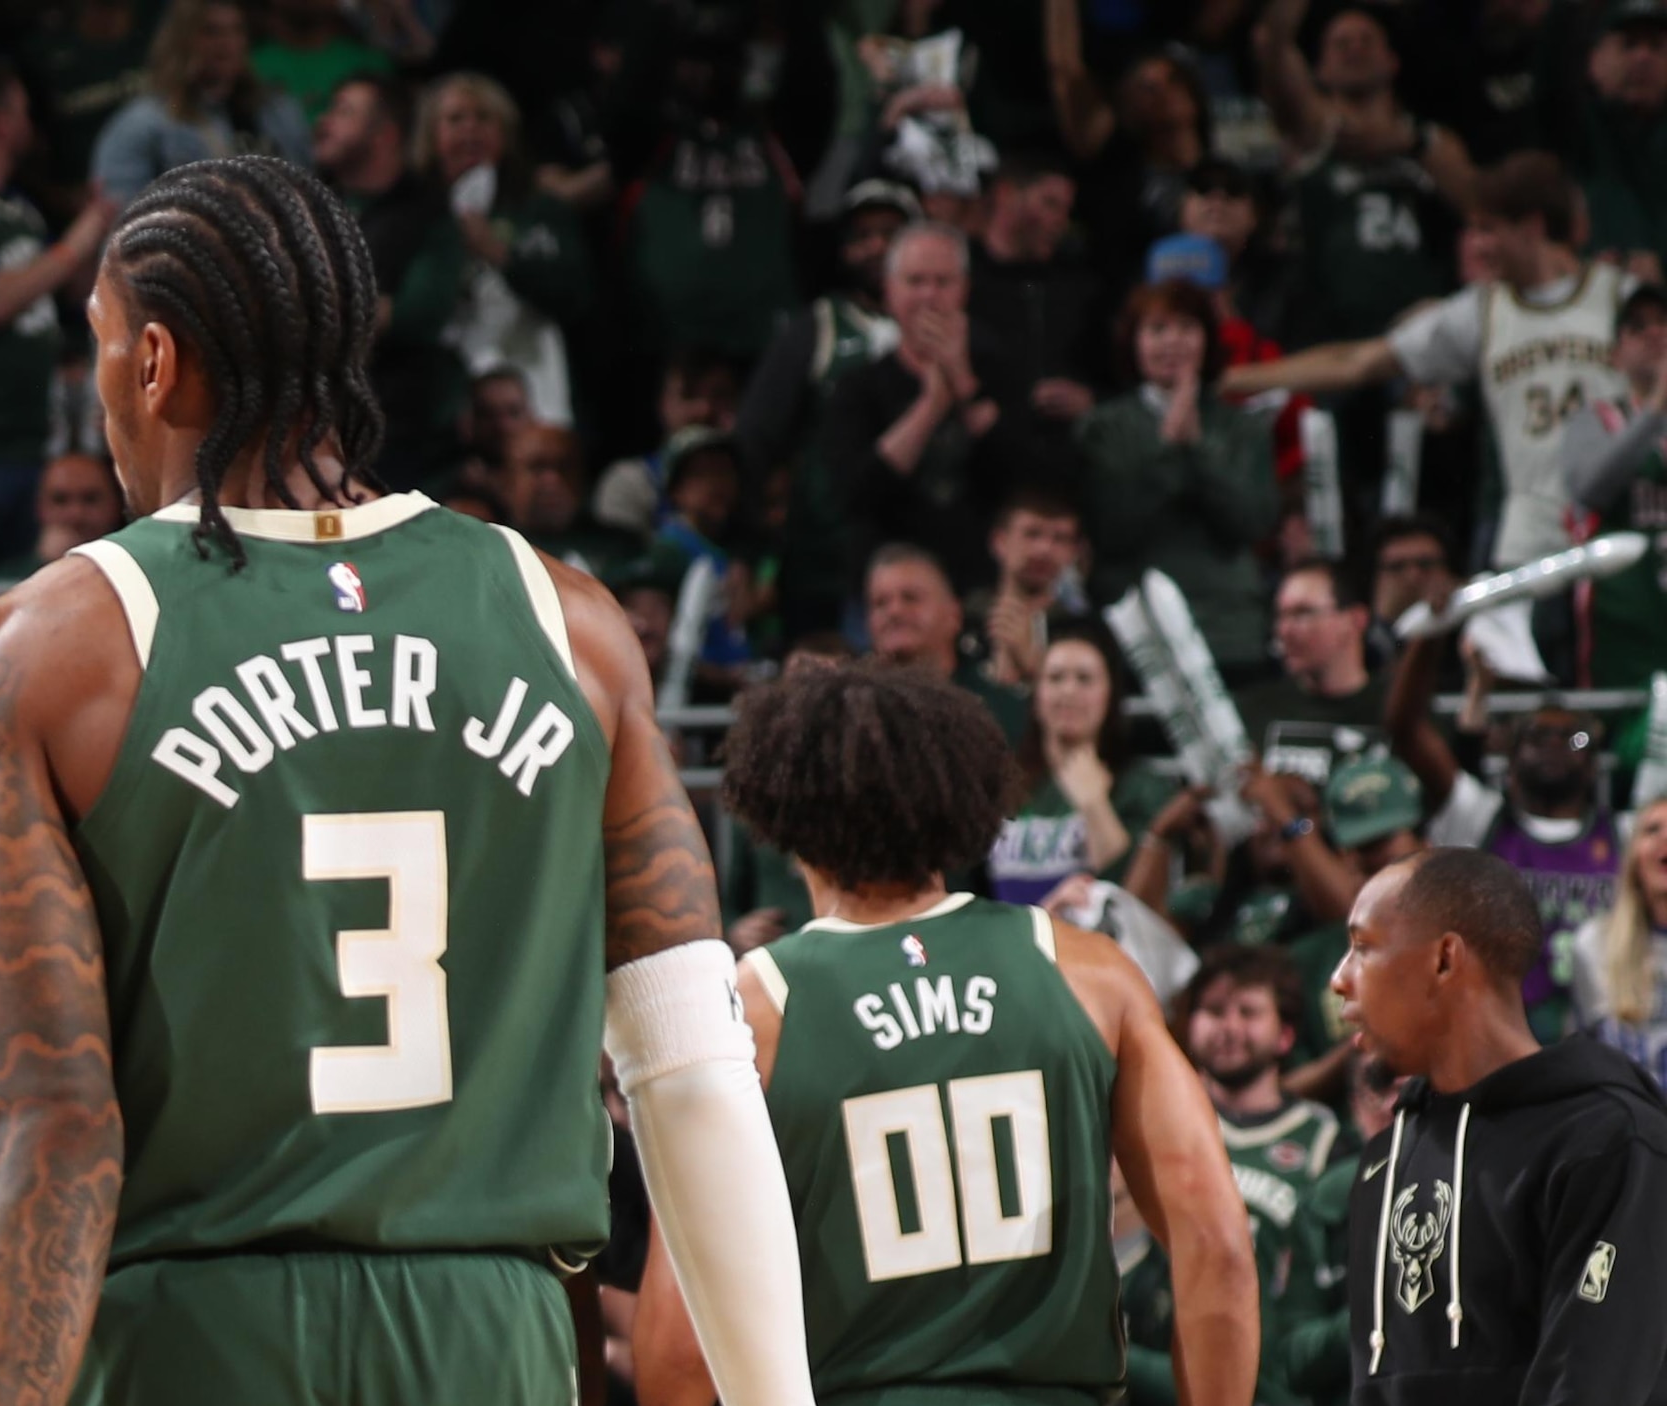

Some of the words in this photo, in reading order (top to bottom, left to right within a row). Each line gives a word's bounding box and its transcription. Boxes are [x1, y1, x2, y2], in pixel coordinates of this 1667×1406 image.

[150, 633, 438, 810] PORTER
[461, 676, 575, 798] JR
[301, 810, 453, 1115] 3
[853, 974, 998, 1051] SIMS
[841, 1069, 1054, 1283] 00
